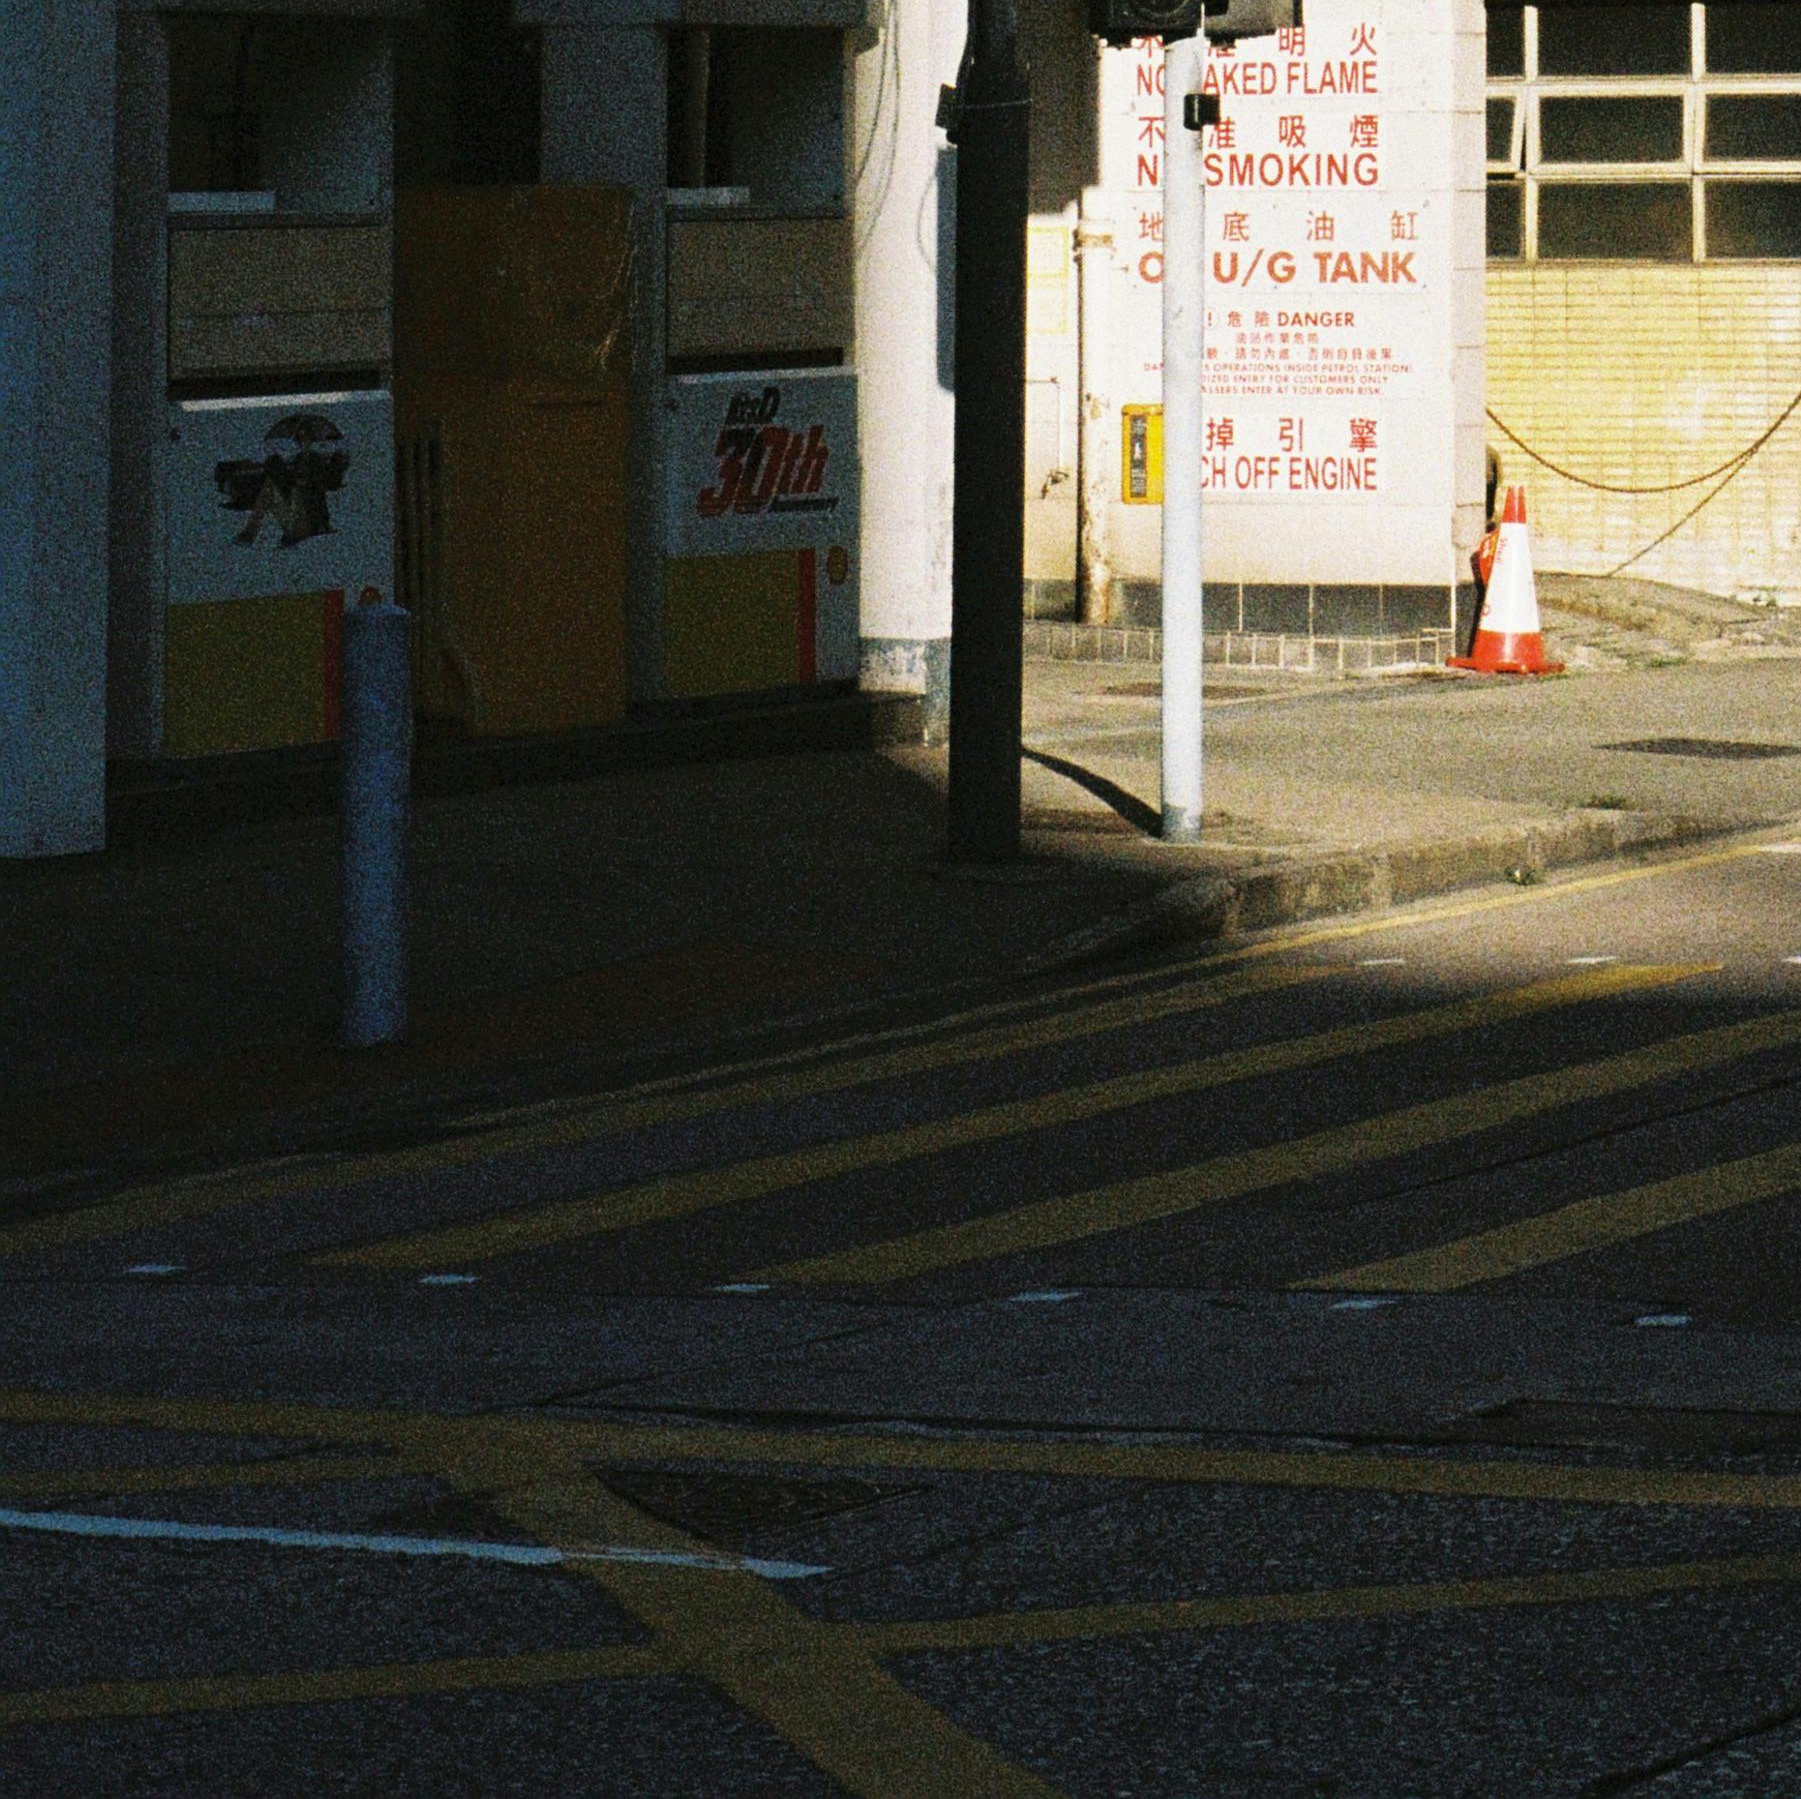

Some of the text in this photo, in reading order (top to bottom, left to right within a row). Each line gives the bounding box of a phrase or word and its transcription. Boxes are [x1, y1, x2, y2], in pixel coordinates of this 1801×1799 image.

[1203, 61, 1277, 96] AKED
[1286, 60, 1378, 95] FLAME
[1204, 152, 1379, 188] SMOKING
[1212, 248, 1418, 287] U/G TANK
[1276, 311, 1356, 328] DANGER
[1205, 417, 1378, 452] 掉引擎
[696, 425, 830, 519] 30th
[1235, 456, 1280, 490] OFF
[1288, 456, 1378, 490] ENGINE
